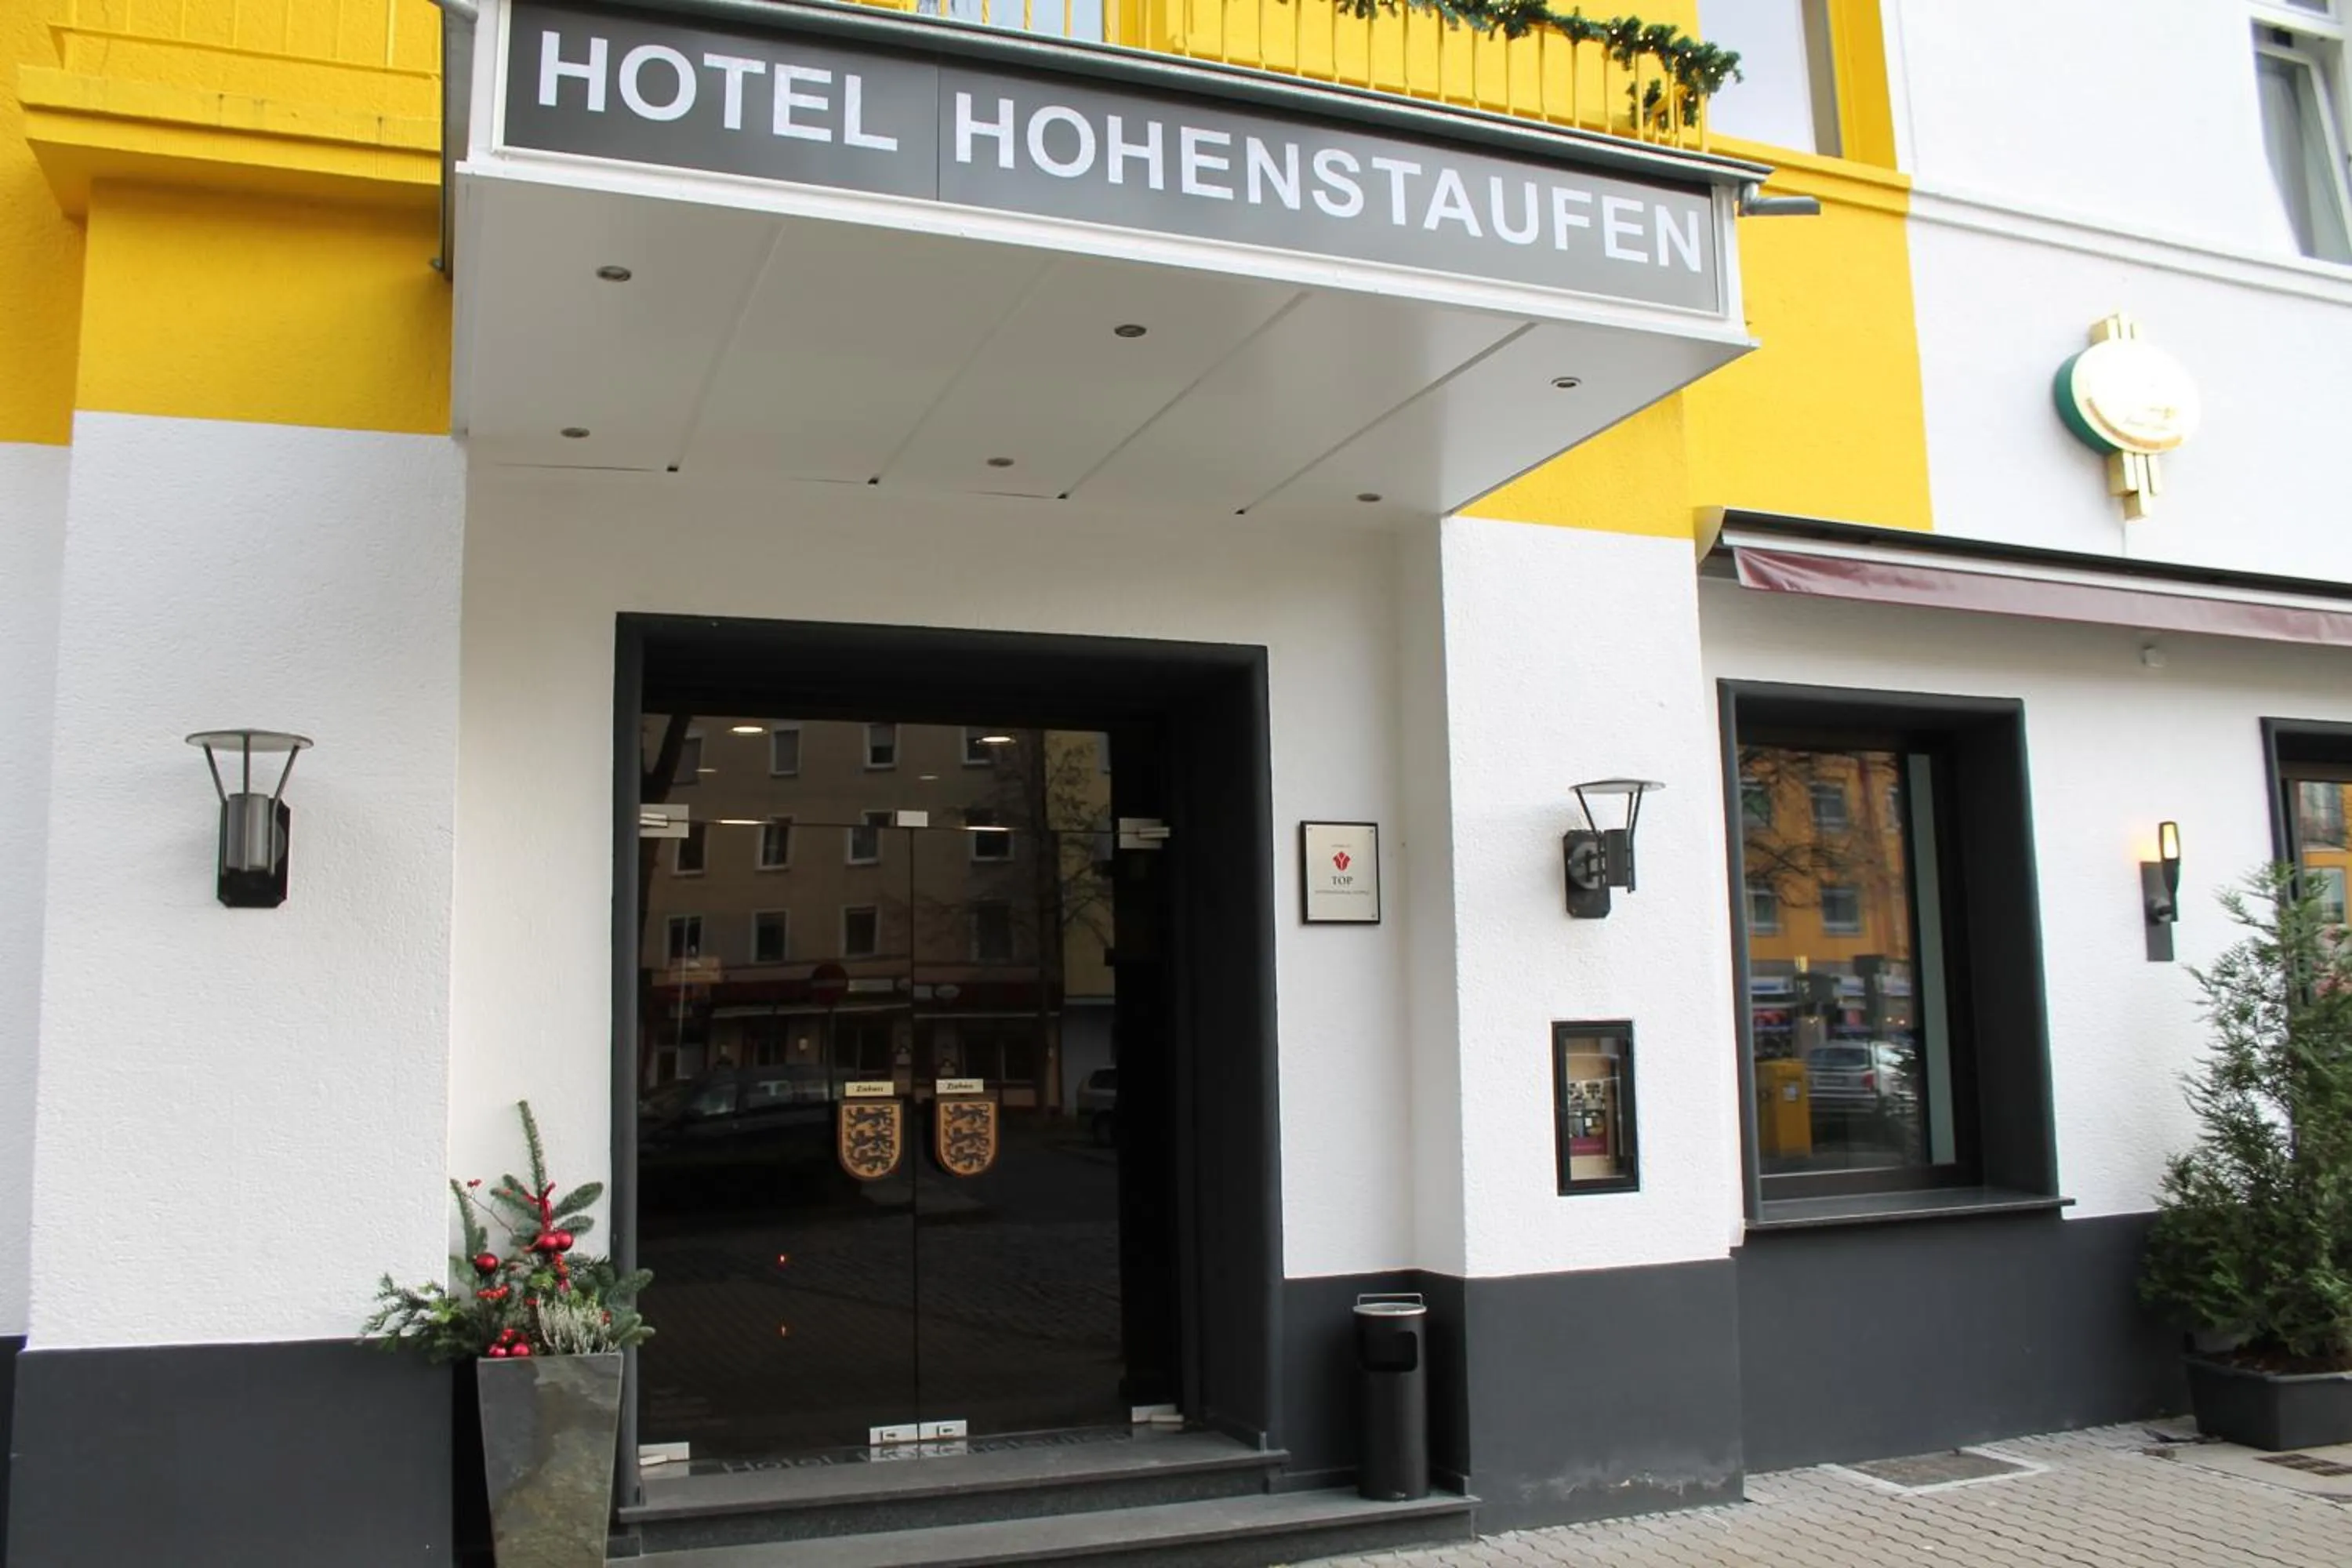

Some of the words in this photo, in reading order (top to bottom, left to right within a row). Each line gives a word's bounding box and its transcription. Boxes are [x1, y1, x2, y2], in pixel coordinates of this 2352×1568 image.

[539, 31, 898, 151] HOTEL
[955, 92, 1702, 273] HOHENSTAUFEN
[1331, 876, 1353, 885] TOP
